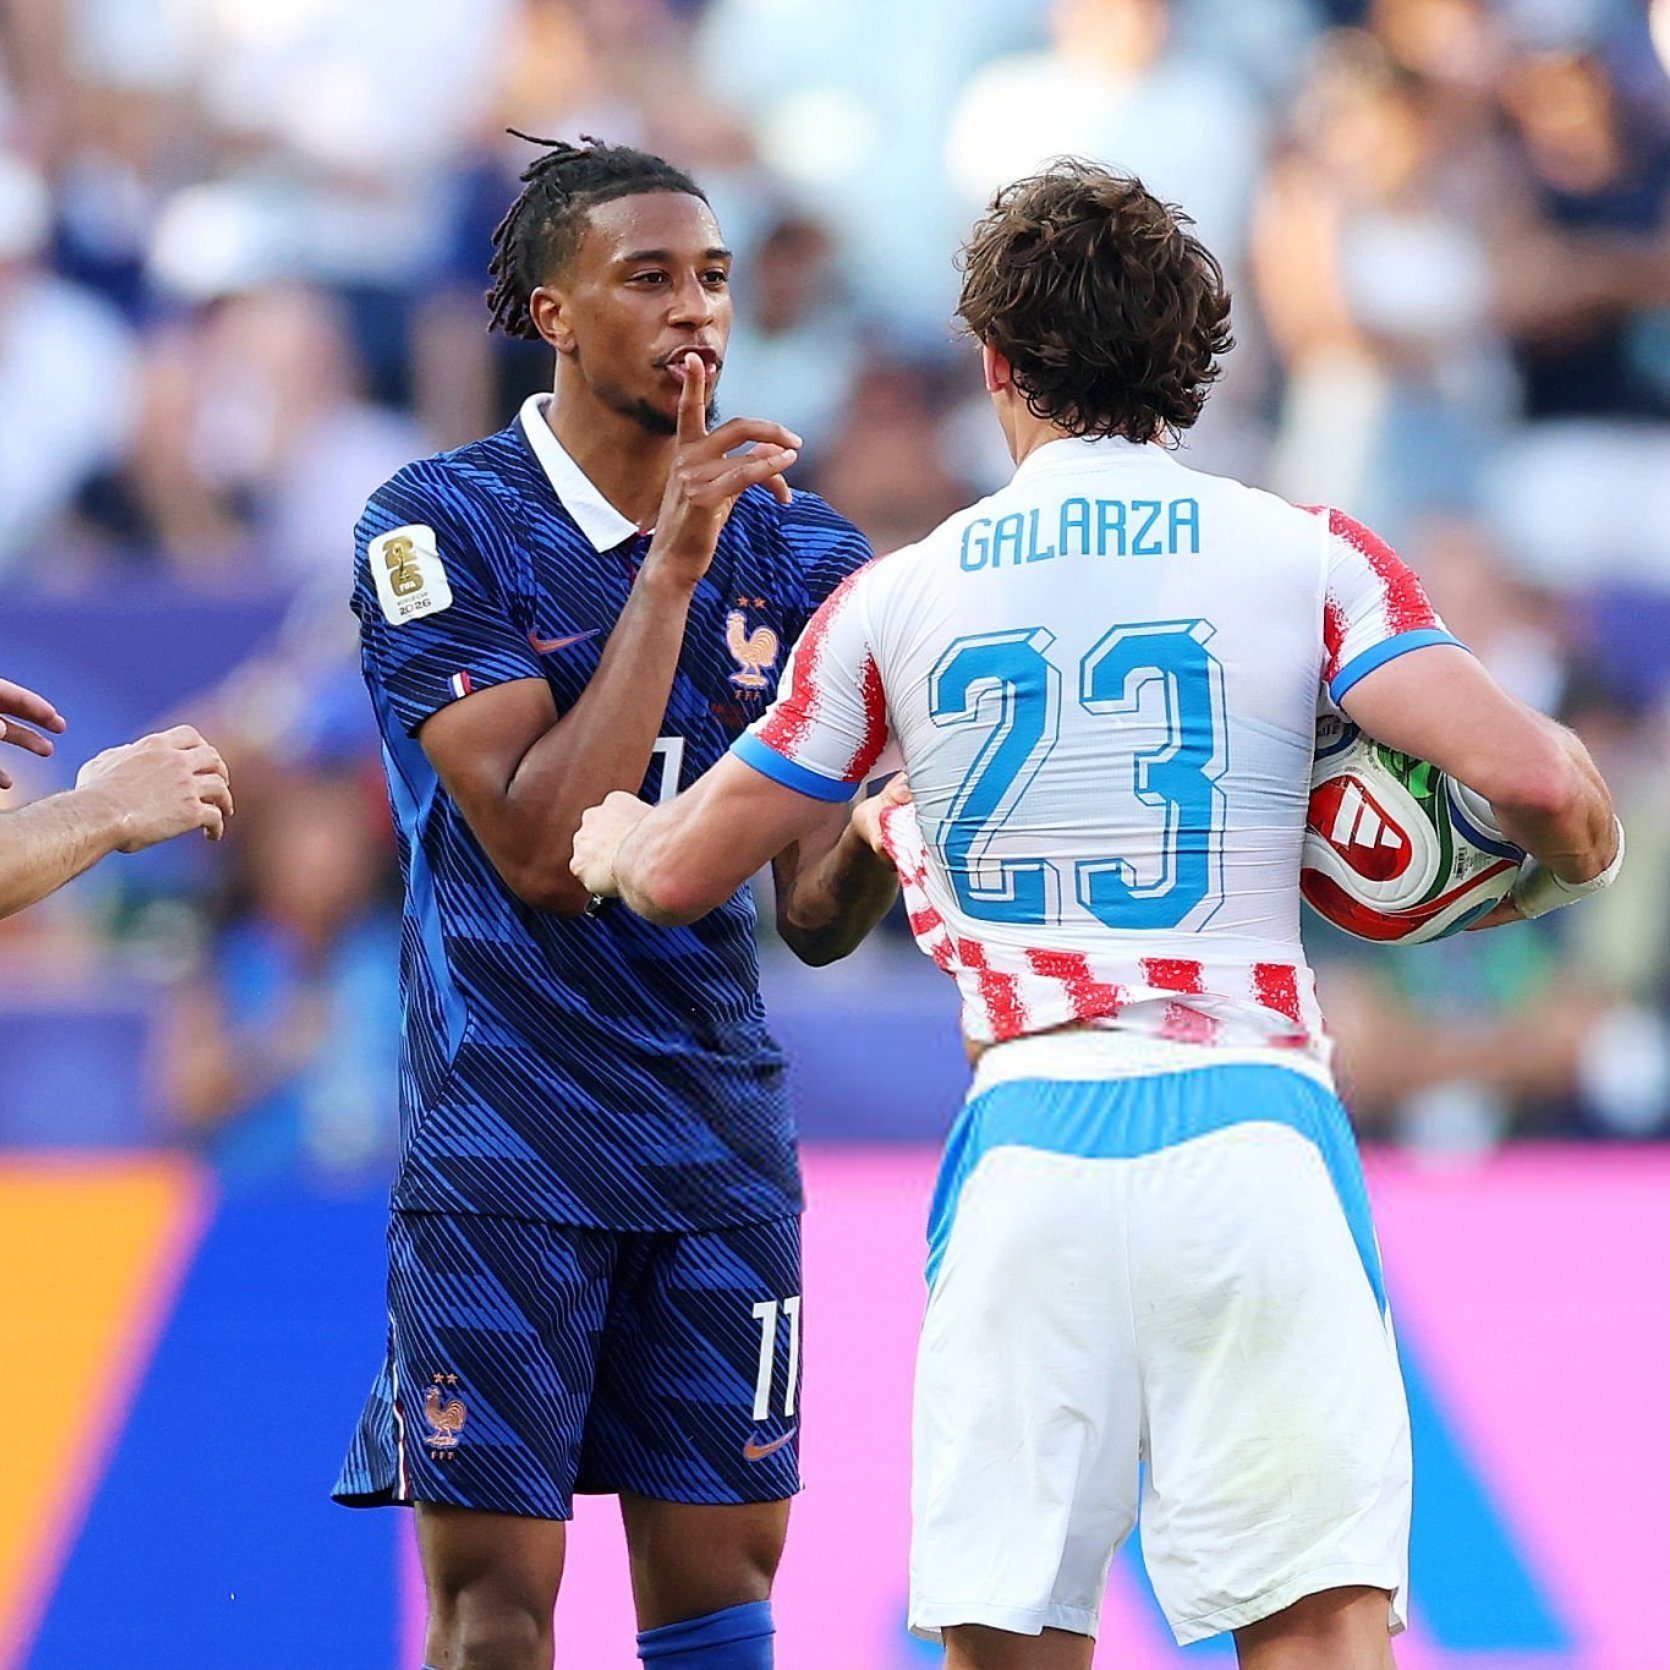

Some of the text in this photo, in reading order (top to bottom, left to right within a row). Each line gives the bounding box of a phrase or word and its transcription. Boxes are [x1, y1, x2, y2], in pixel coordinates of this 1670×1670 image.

[960, 498, 1200, 572] GALARZA
[399, 598, 432, 615] 2026
[929, 618, 1229, 933] 23
[752, 1296, 800, 1421] 11
